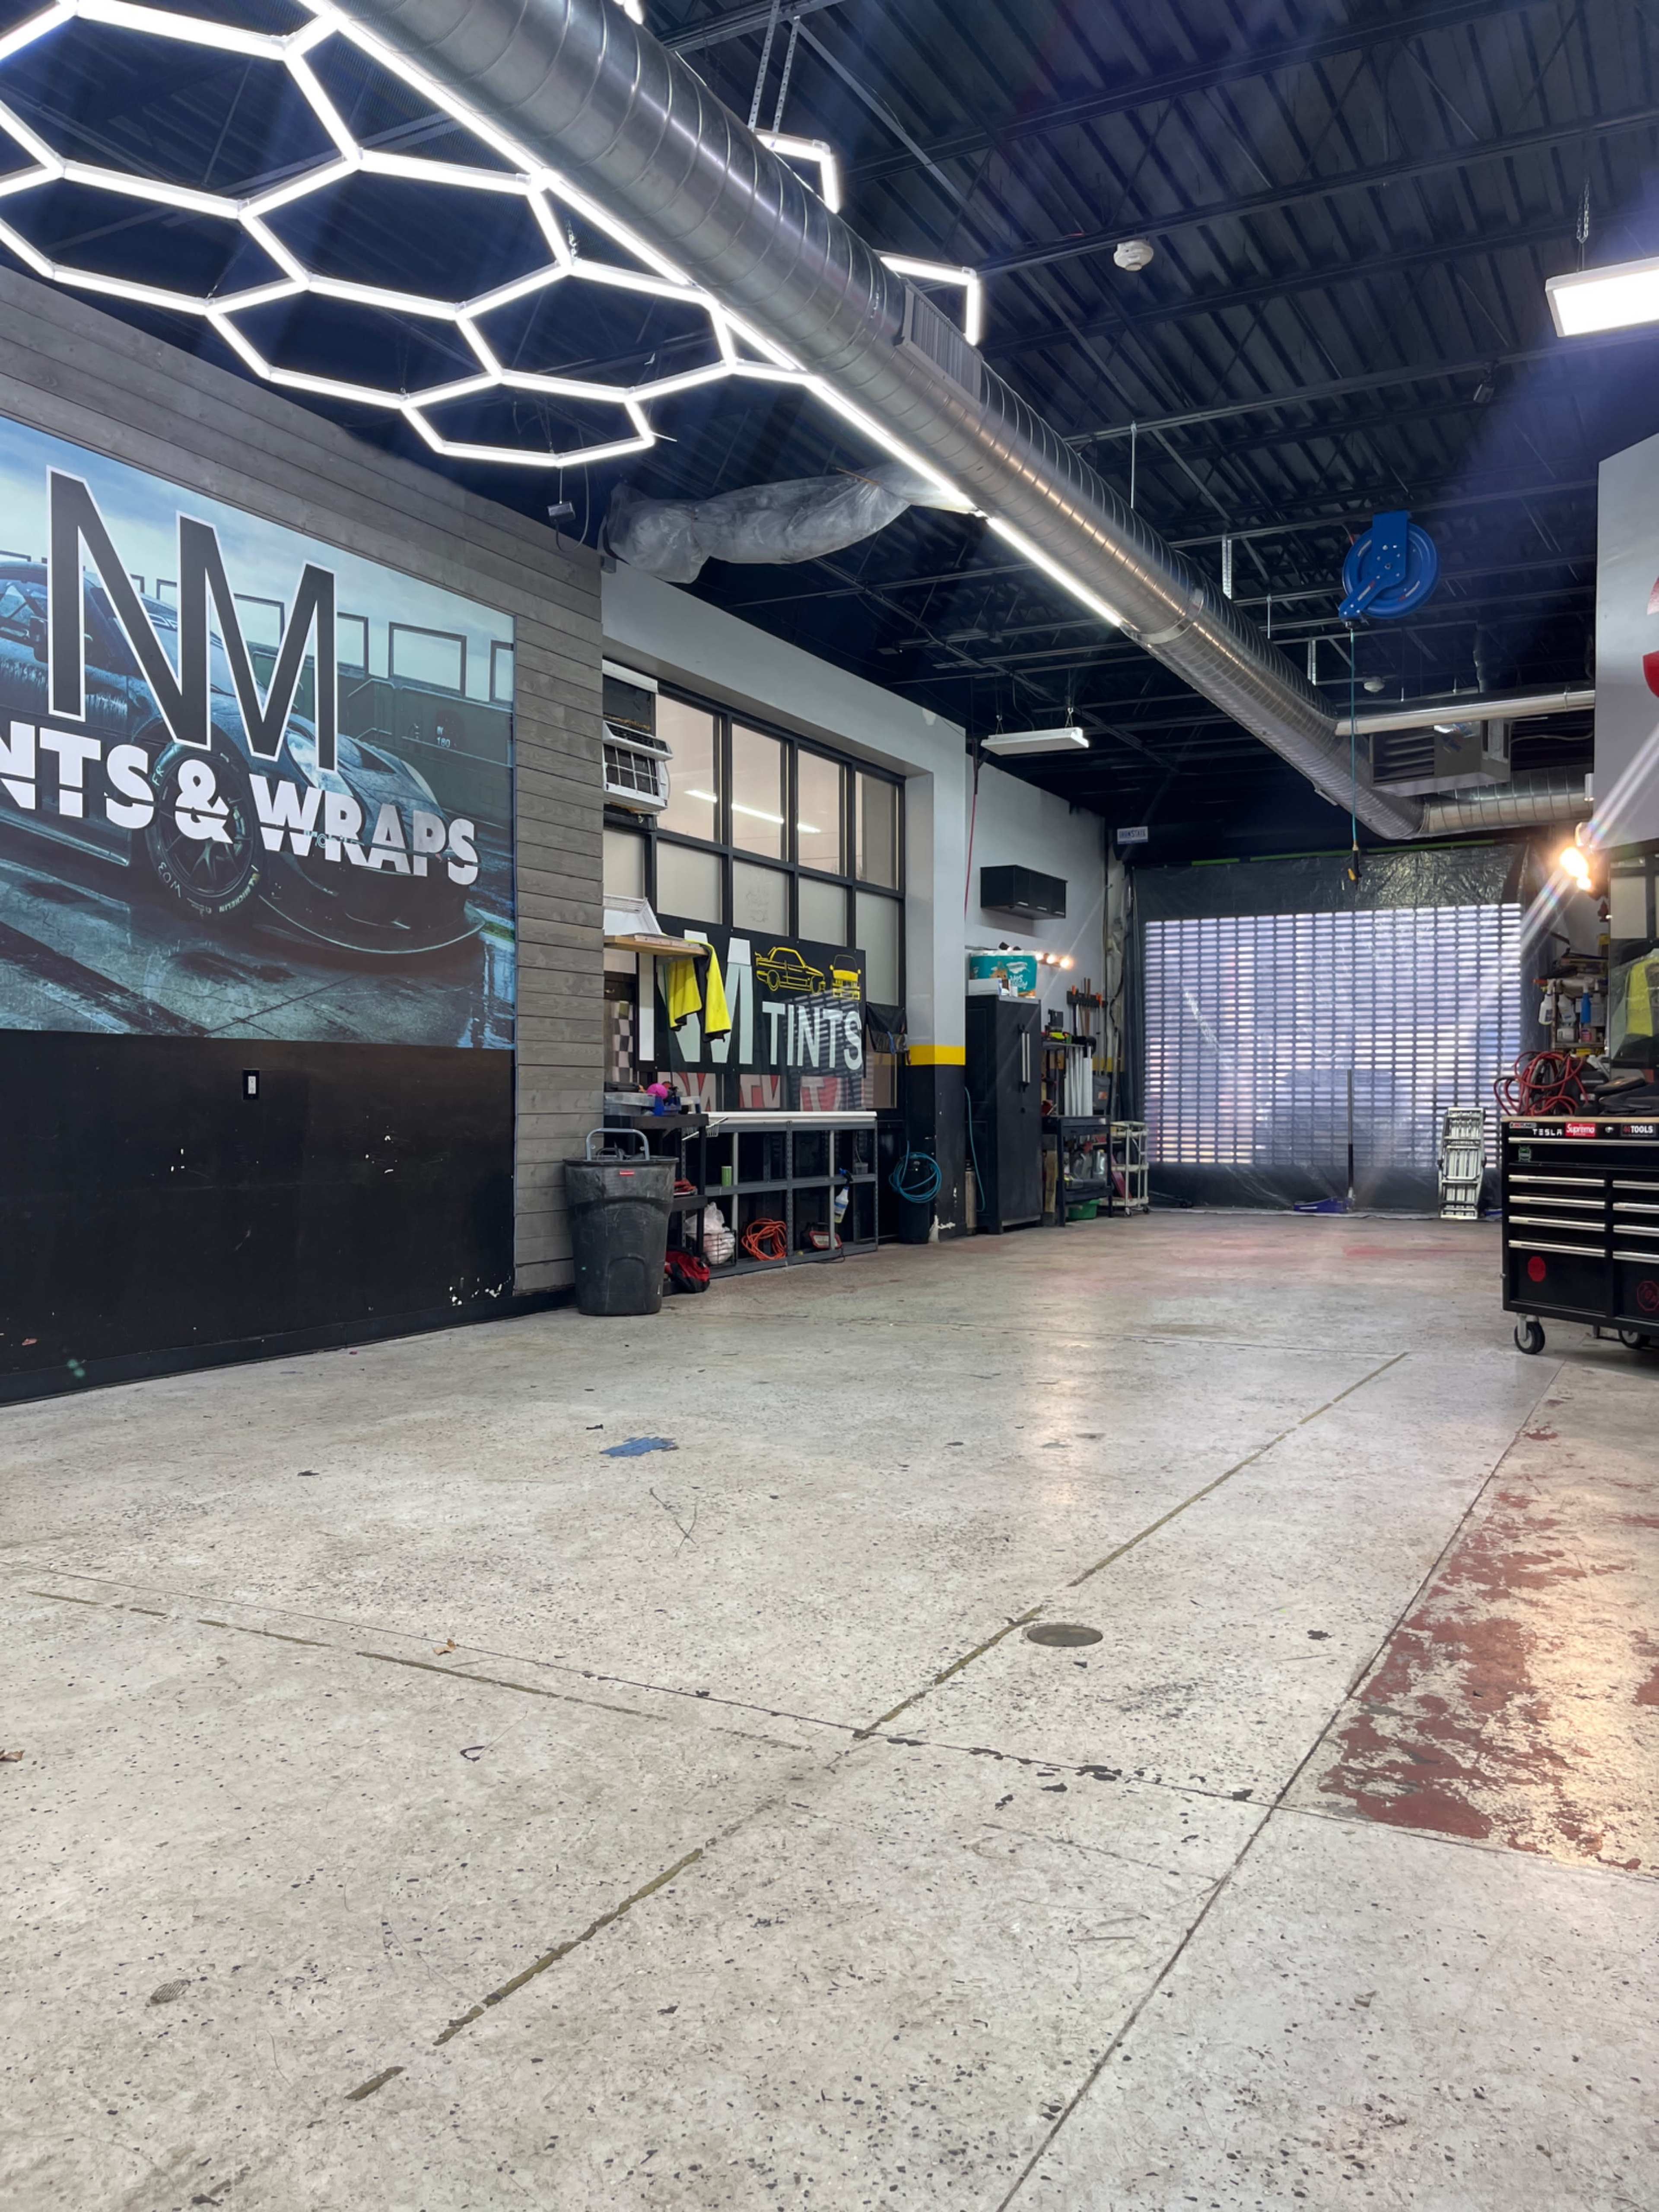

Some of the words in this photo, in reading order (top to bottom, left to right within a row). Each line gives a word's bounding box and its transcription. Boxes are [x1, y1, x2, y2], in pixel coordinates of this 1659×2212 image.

[175, 759, 234, 844] &
[249, 773, 478, 885] WRAPS
[219, 886, 251, 912] MICHELIN
[762, 1001, 863, 1070] TINTS
